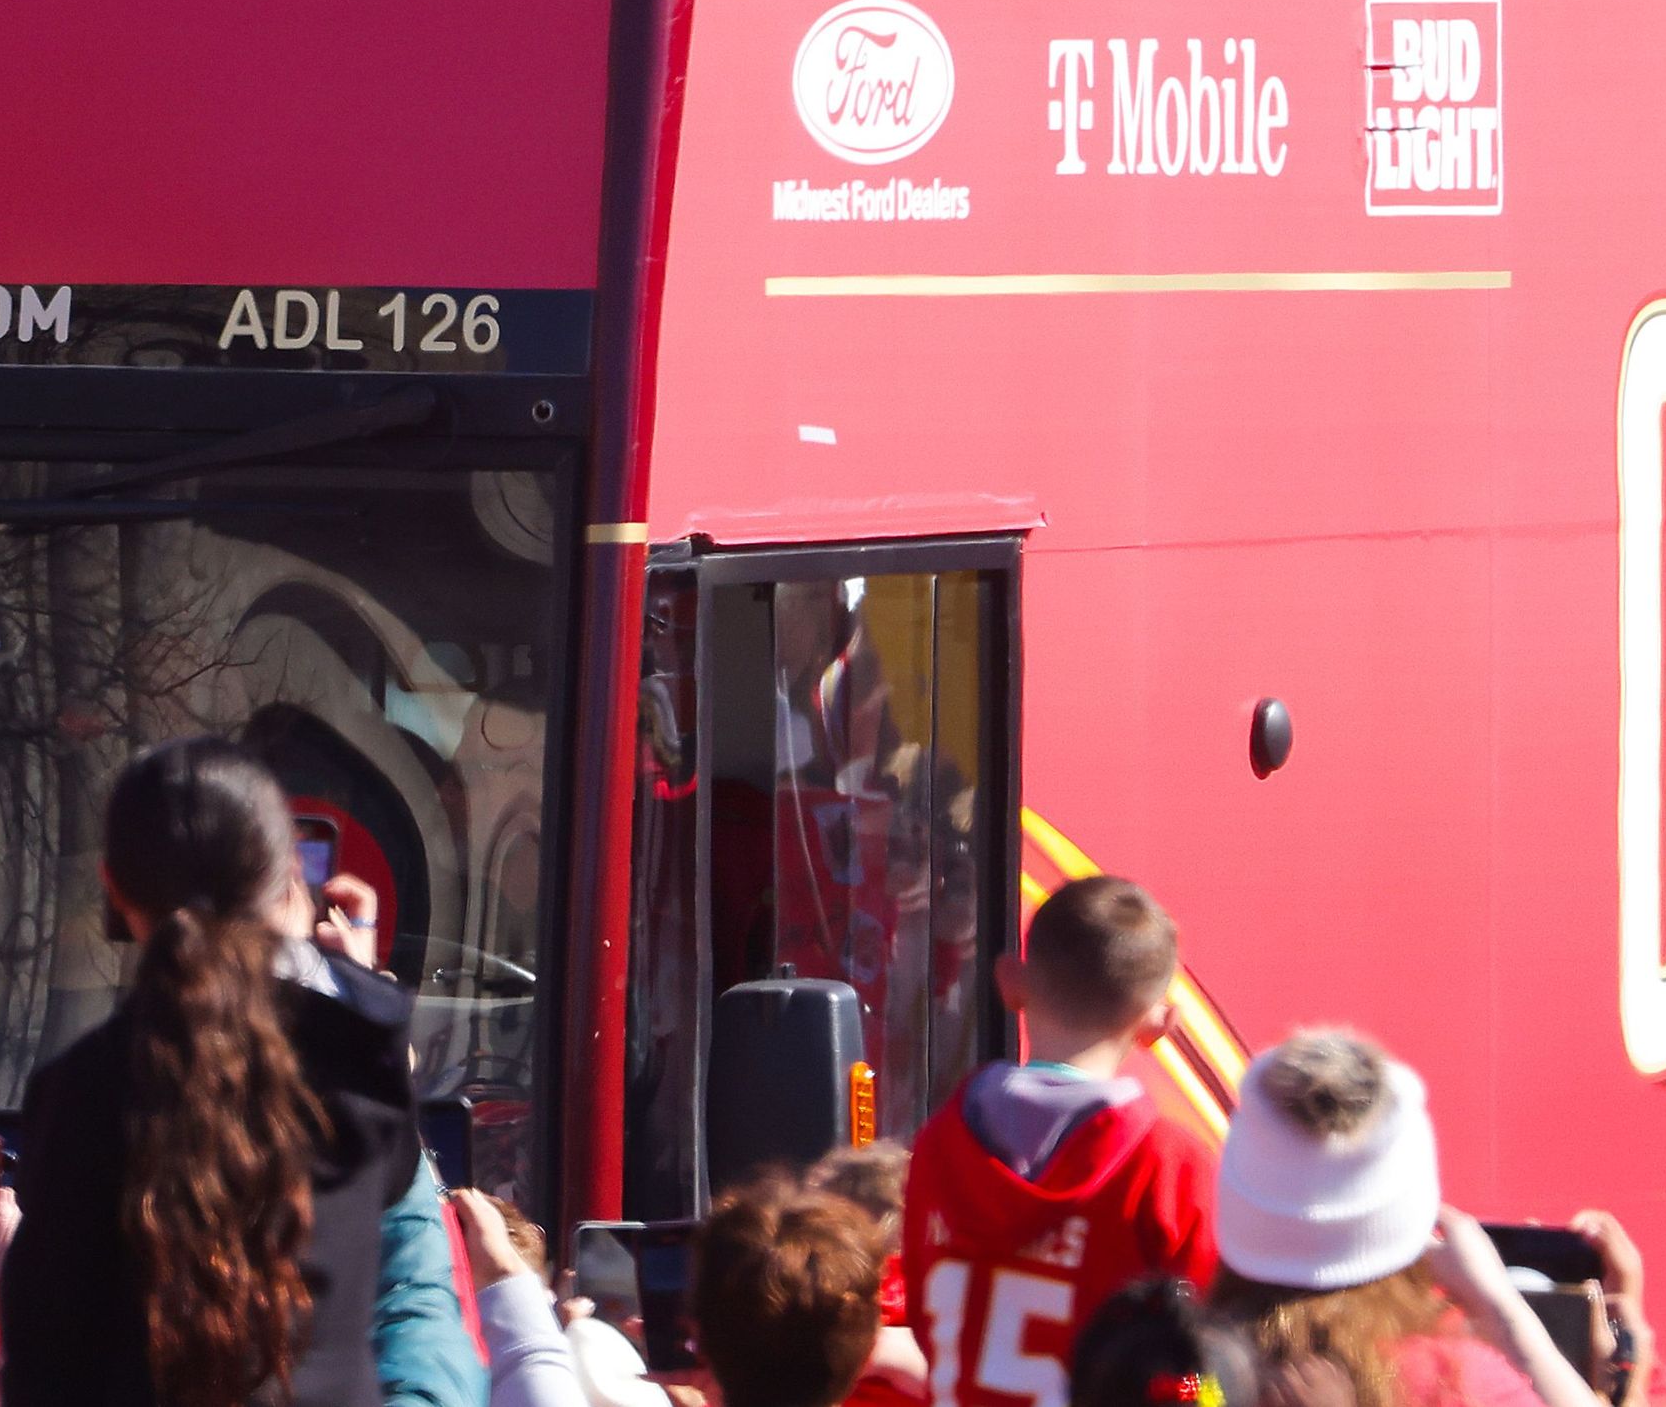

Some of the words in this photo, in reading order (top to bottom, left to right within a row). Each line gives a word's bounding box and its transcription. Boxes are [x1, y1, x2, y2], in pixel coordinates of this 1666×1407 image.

[826, 25, 921, 127] Ford
[1392, 19, 1482, 102] BUD
[1107, 38, 1289, 176] Mobile
[1374, 106, 1498, 192] LIGHT
[772, 178, 849, 221] Midwest
[851, 178, 896, 221] Ford
[897, 177, 971, 221] Dealers
[218, 289, 365, 352] ADL
[377, 291, 502, 355] 126
[922, 1257, 1077, 1407] 15
